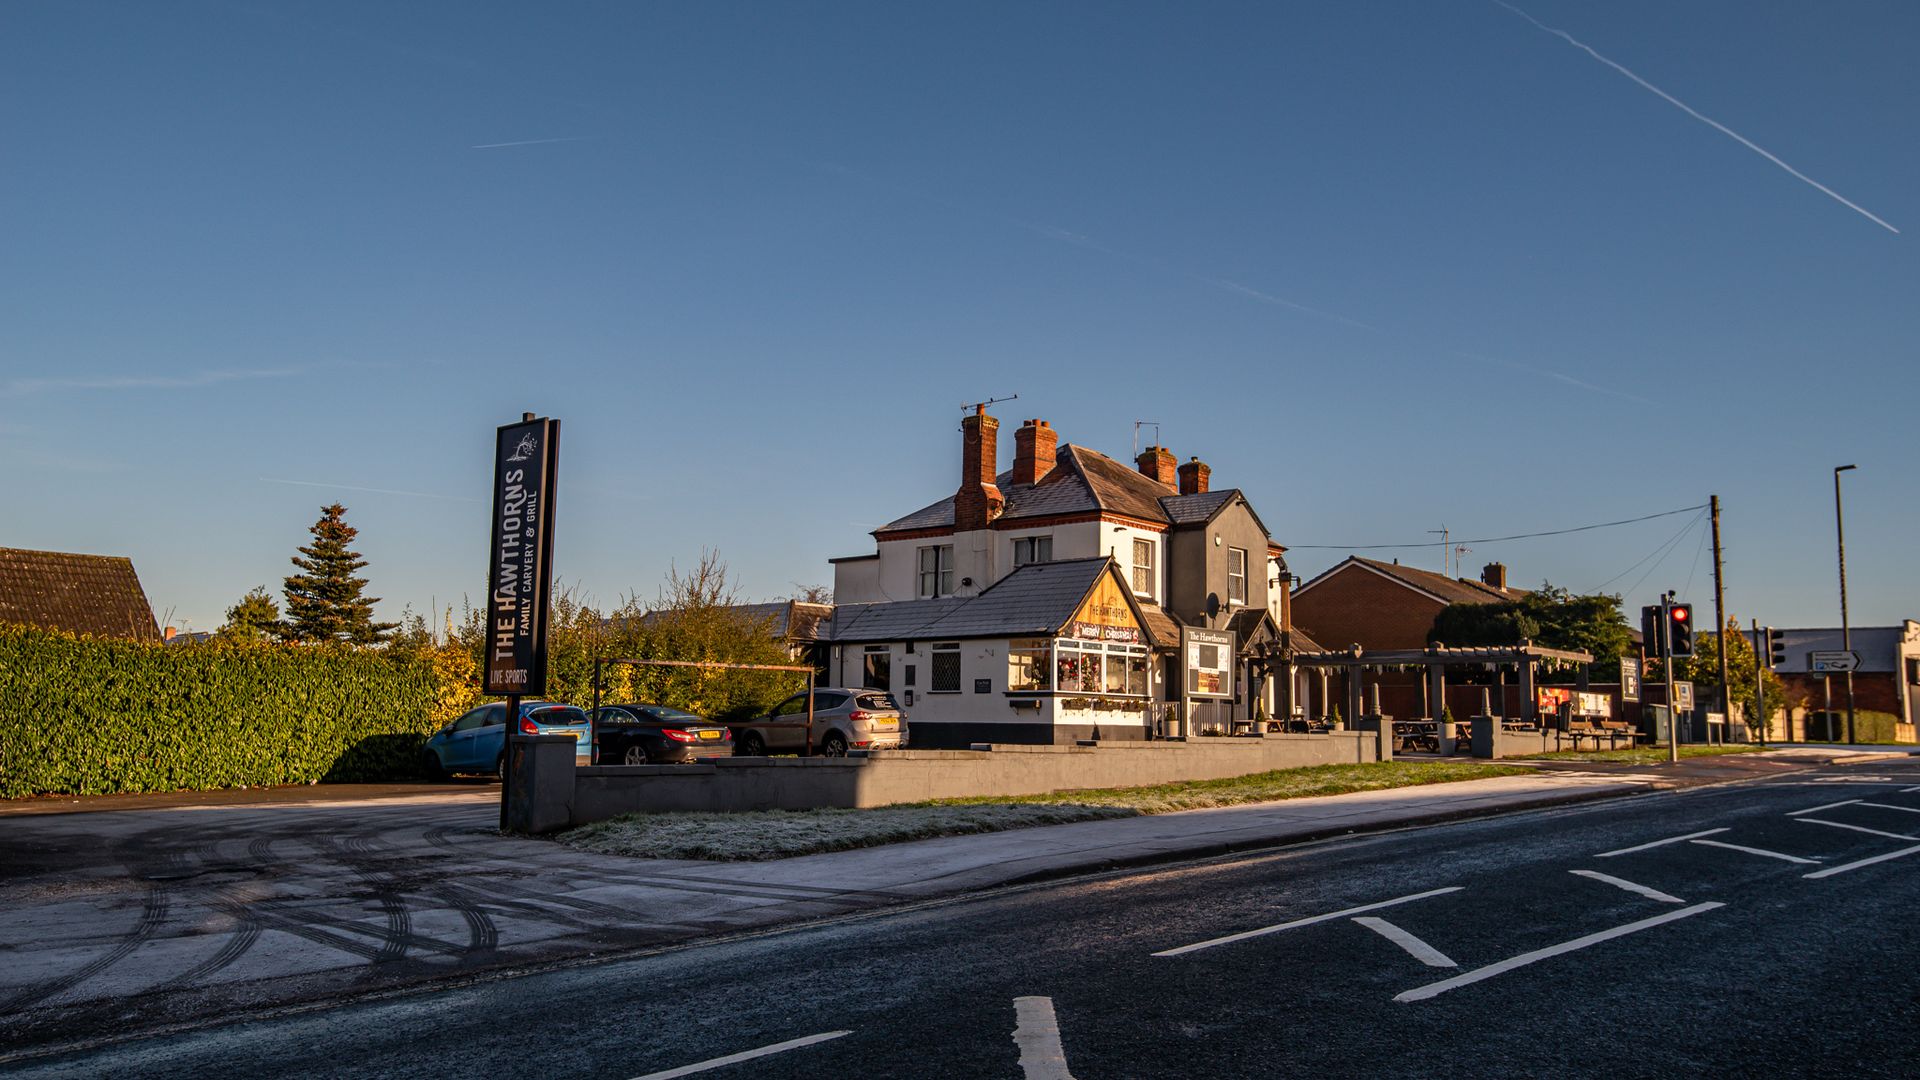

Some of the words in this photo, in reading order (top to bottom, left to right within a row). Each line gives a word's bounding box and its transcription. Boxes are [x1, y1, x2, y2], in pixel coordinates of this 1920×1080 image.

[526, 490, 537, 522] GRILL
[494, 469, 527, 611] HAWTHORNS
[525, 527, 535, 538] &
[522, 543, 534, 592] CARVERY
[520, 598, 531, 636] FAMILY
[1090, 604, 1099, 616] THE
[1099, 603, 1128, 621] HAWTHORNS
[495, 617, 516, 661] THE
[1081, 625, 1100, 637] MERRY
[1105, 629, 1132, 640] CHRISTMAS
[1189, 631, 1200, 641] The
[1200, 632, 1228, 643] Hawthorns
[490, 670, 504, 684] LIVE
[504, 669, 528, 684] SPORTS
